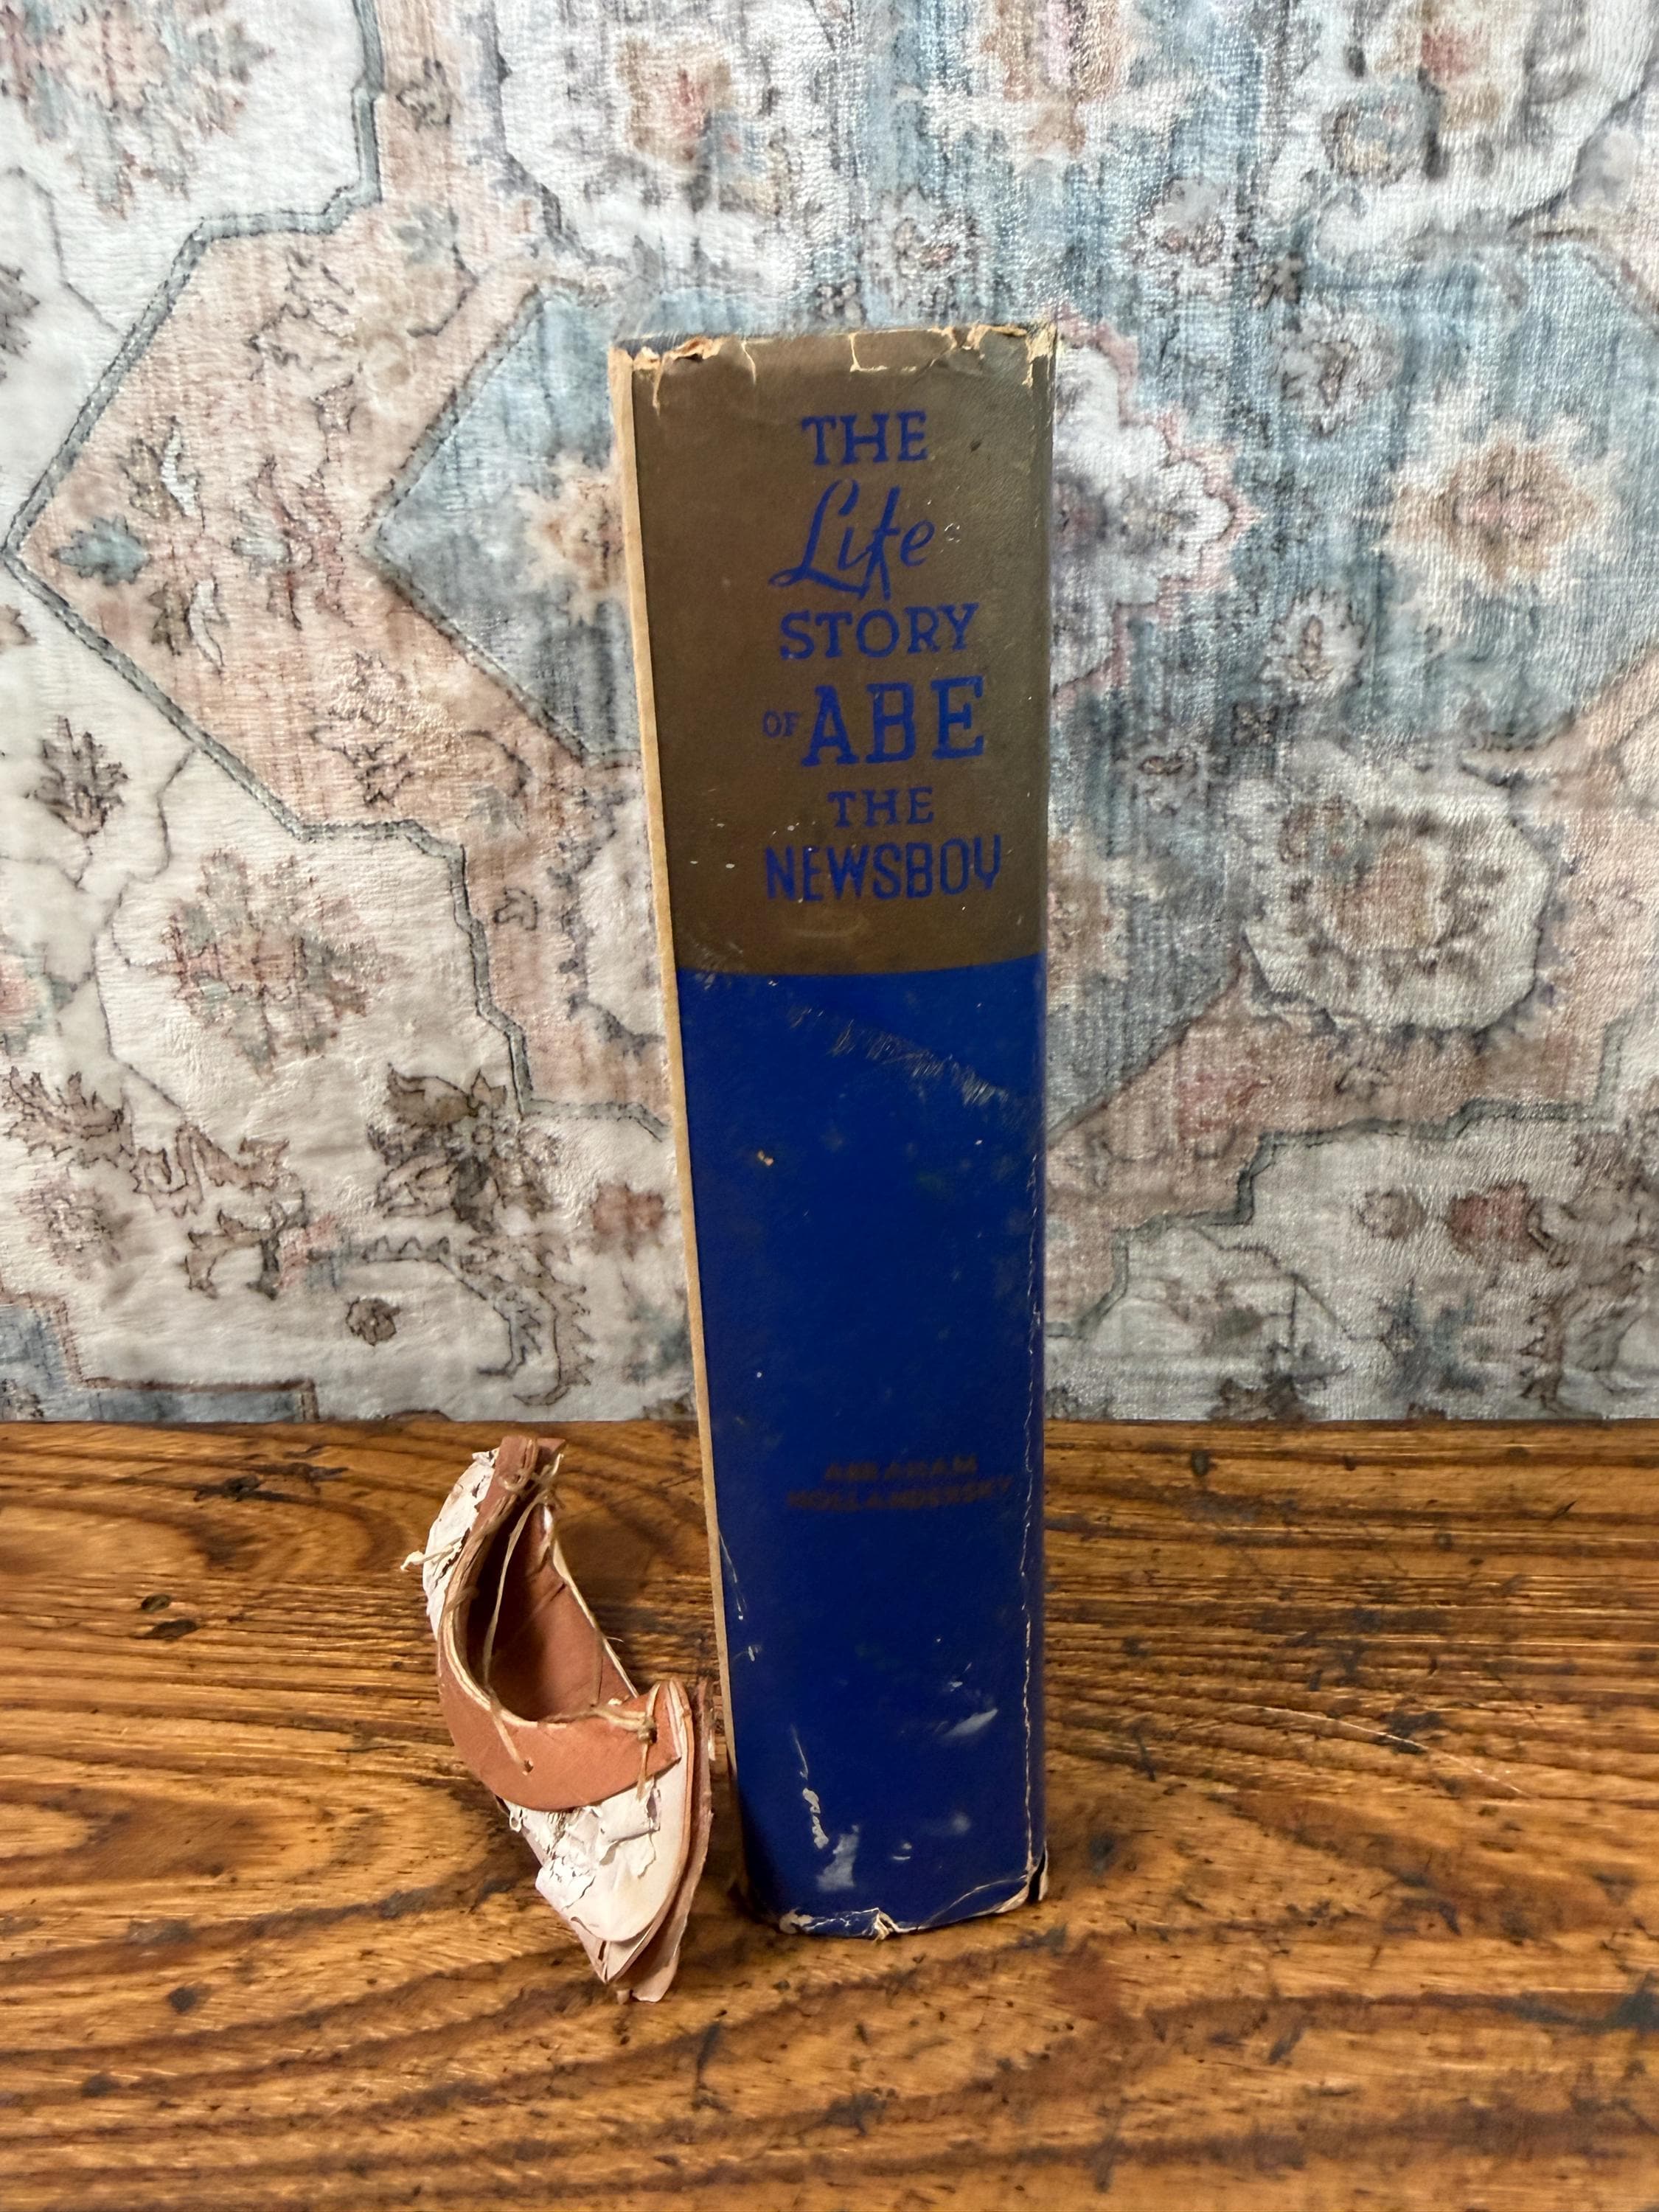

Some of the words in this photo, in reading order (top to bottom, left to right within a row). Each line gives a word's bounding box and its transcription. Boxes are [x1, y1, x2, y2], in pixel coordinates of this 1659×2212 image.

[801, 410, 928, 465] THE
[768, 479, 936, 601] Life
[779, 602, 980, 660] STORY
[762, 709, 800, 737] OF
[801, 675, 984, 767] ABE
[827, 786, 934, 828] THE
[765, 834, 1002, 902] NEWSBOY
